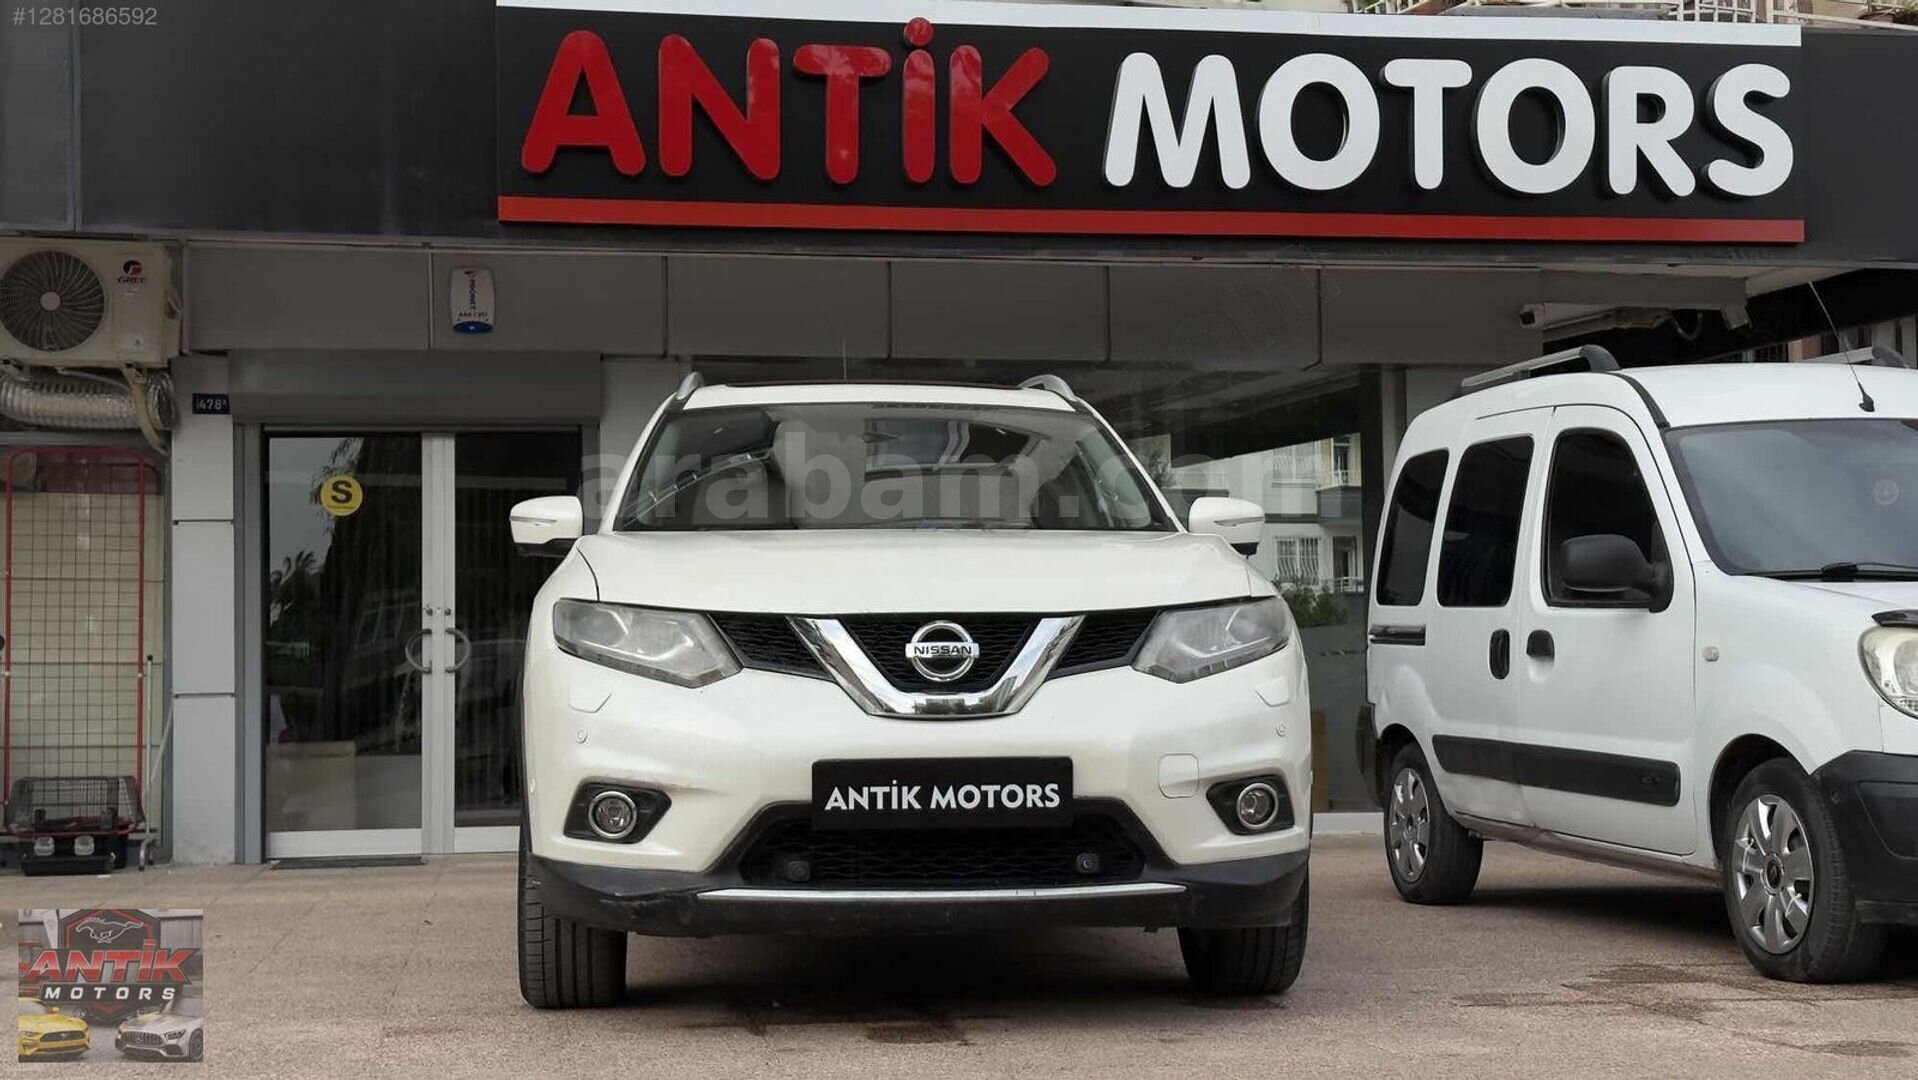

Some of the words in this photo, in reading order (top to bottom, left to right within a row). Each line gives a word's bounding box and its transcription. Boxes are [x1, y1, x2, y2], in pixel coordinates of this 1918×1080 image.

[521, 17, 1057, 188] ANTİK
[1103, 51, 1794, 198] MOTORS
[331, 480, 353, 503] S
[914, 645, 972, 655] NISSAN
[824, 779, 922, 811] ANTİK
[930, 783, 1061, 809] MOTORS
